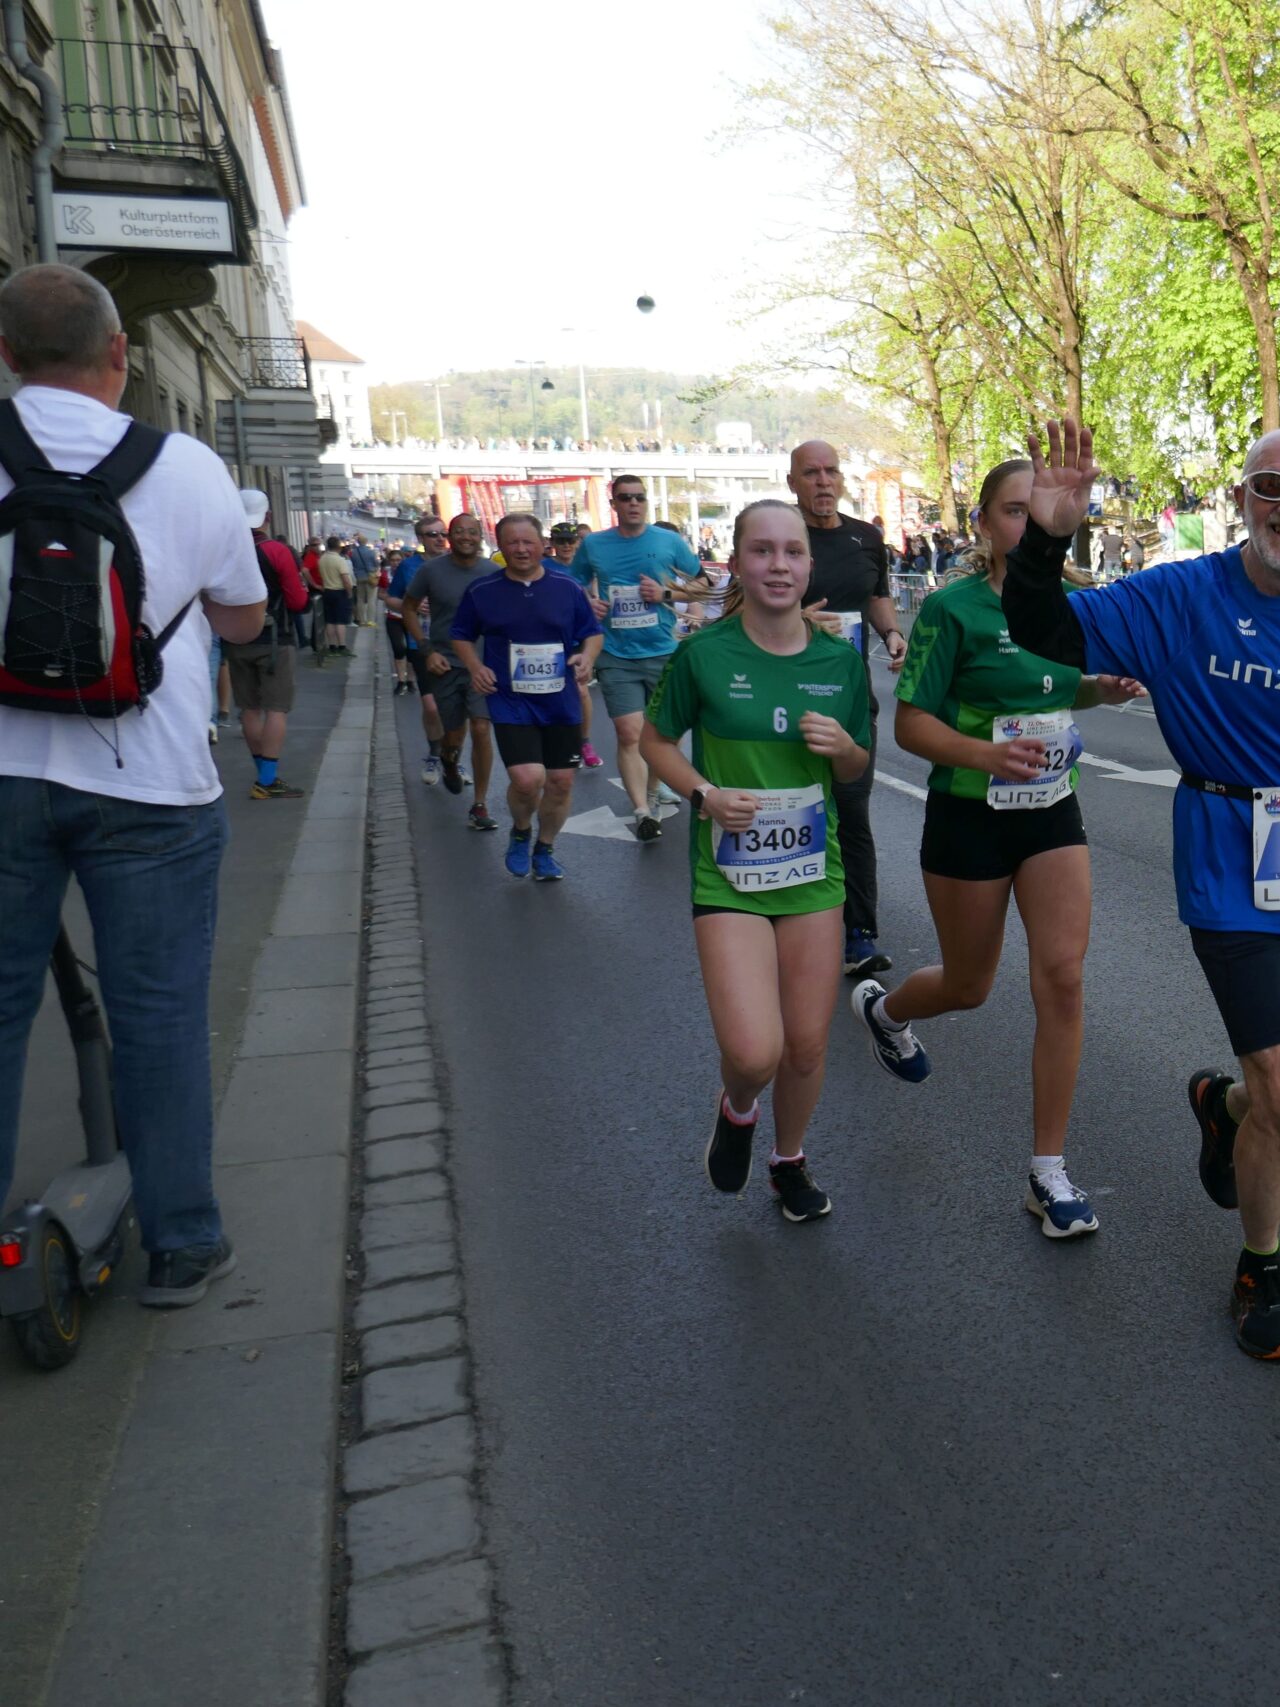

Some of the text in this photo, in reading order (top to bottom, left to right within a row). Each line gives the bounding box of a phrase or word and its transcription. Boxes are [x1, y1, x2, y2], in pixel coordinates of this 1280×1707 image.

[119, 208, 219, 224] Kulturplattform
[121, 224, 220, 240] Oberösterreich
[520, 663, 559, 675] 10437
[1043, 674, 1053, 694] 9
[773, 706, 788, 733] 6
[994, 791, 1049, 804] LINZ
[758, 817, 786, 826] Hanna
[729, 825, 812, 853] 13408
[785, 862, 819, 881] AG
